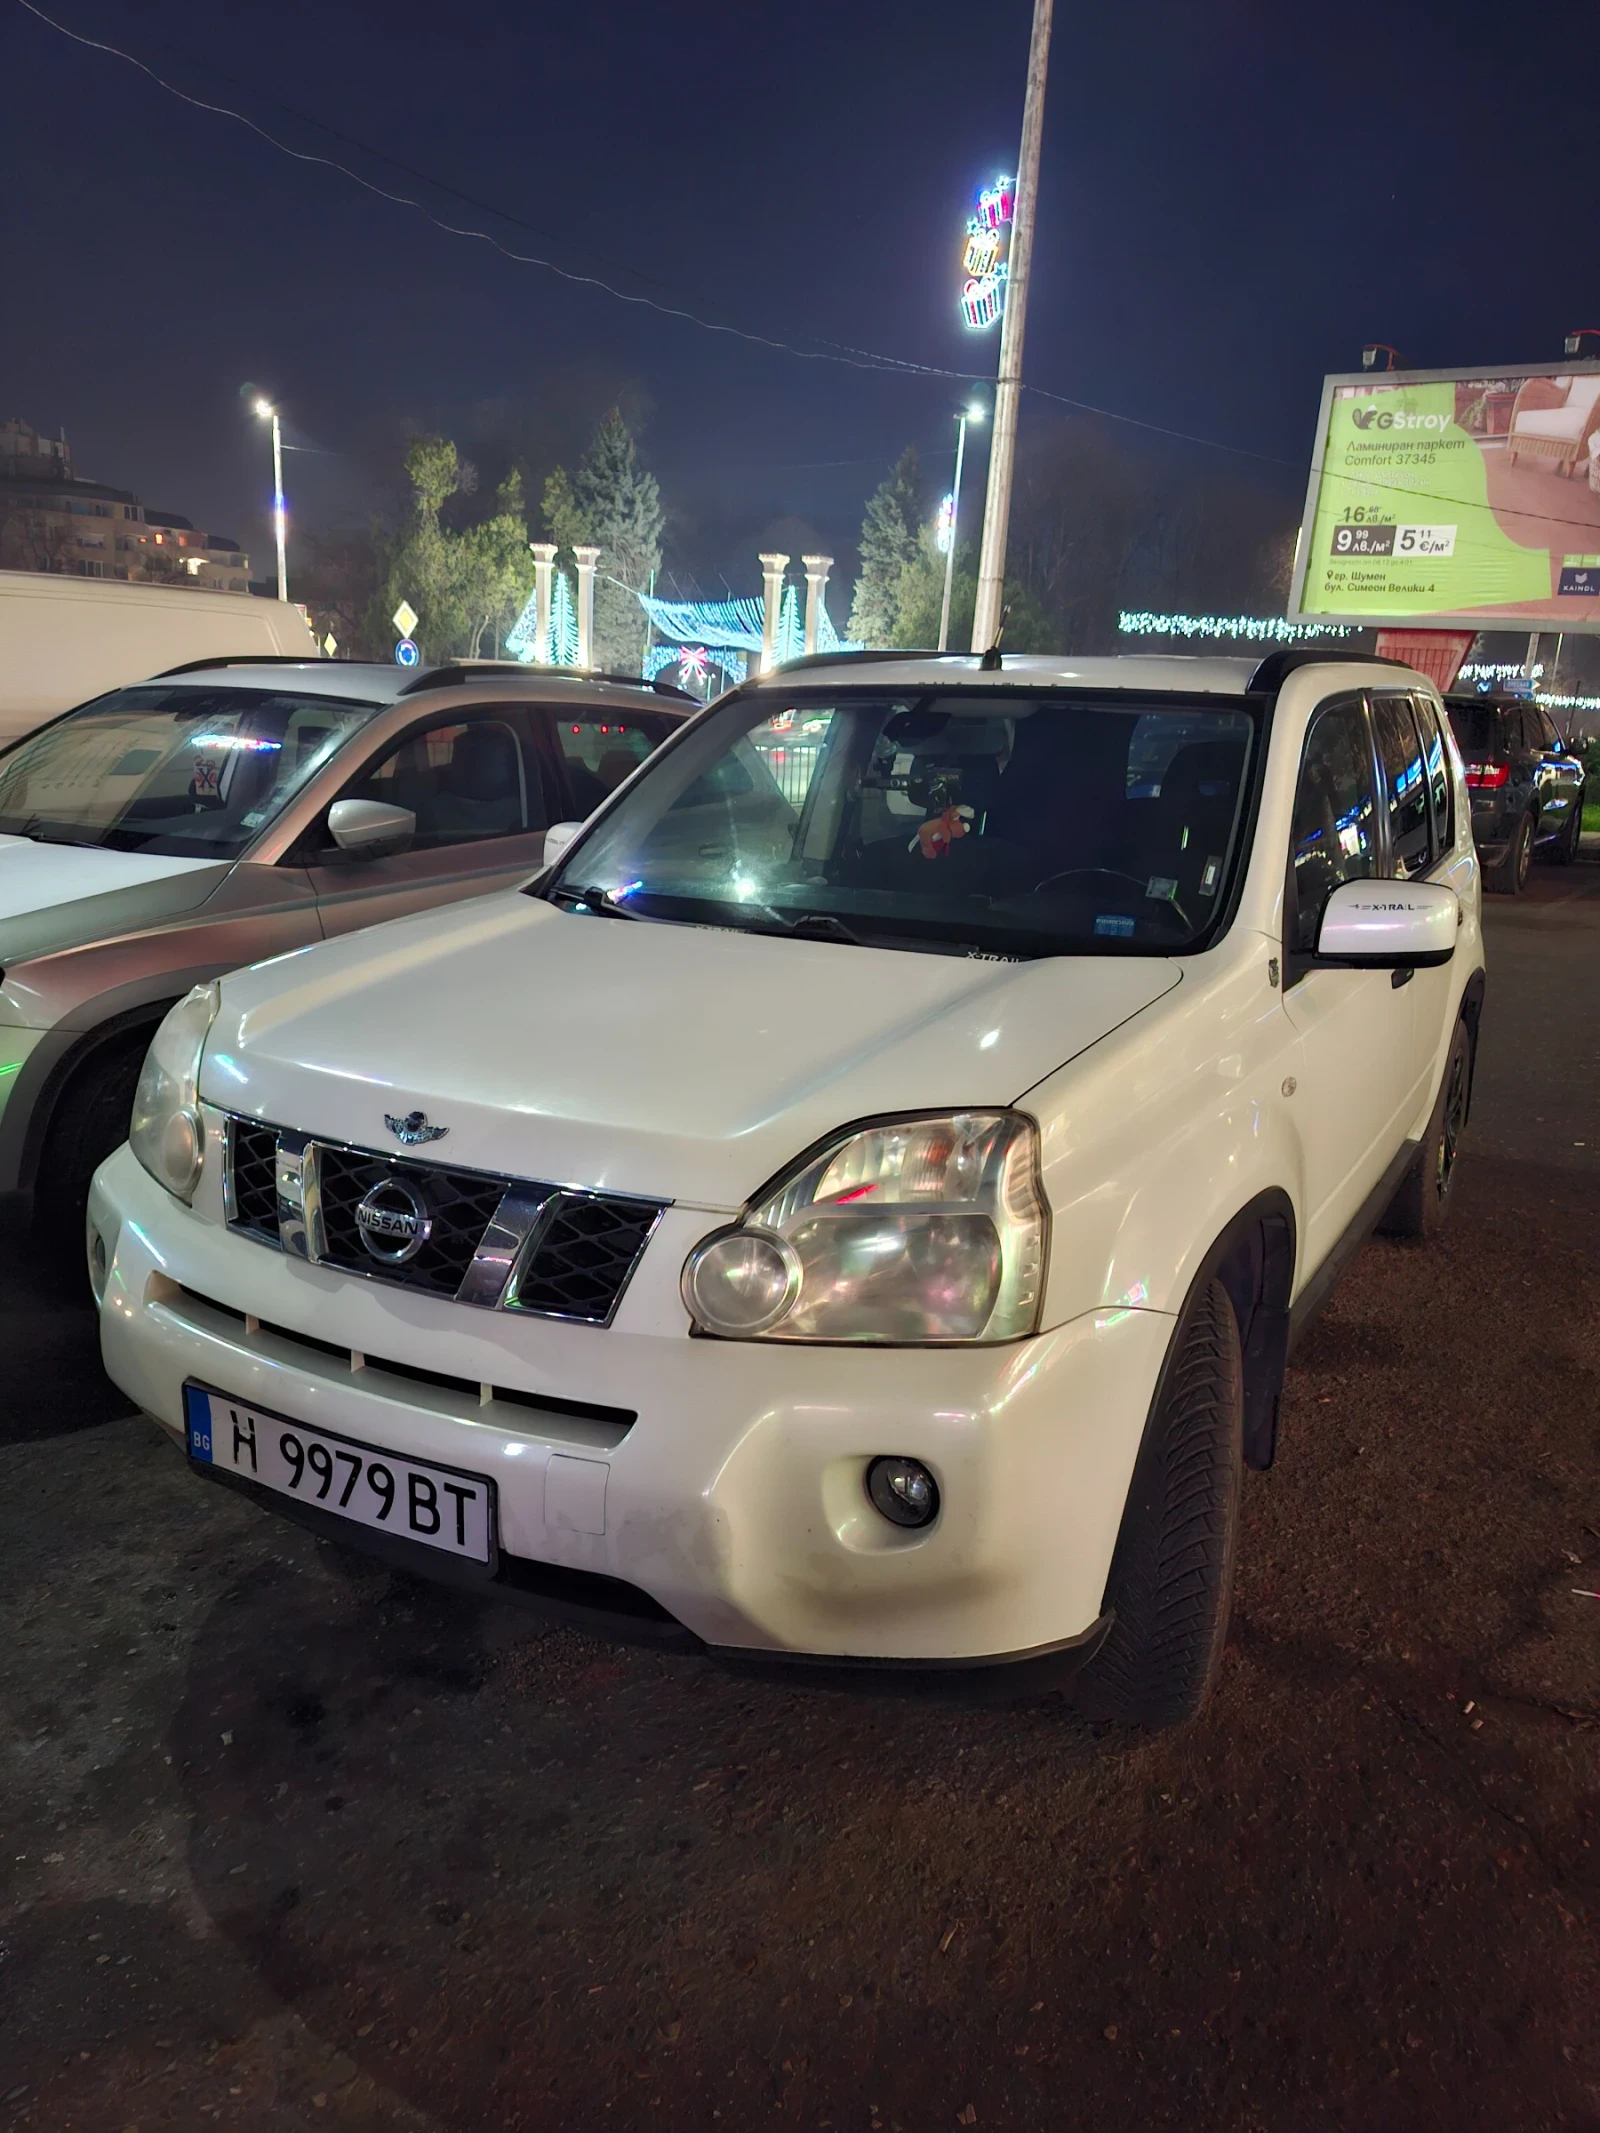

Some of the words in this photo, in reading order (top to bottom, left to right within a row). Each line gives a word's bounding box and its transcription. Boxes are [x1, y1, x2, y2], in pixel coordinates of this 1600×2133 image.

[1346, 440, 1414, 453] Ламиниран
[1416, 438, 1465, 452] паркет
[1344, 454, 1392, 466] Comfort
[1395, 452, 1436, 465] 37345
[1343, 506, 1366, 523] 16
[1336, 529, 1353, 552] 9
[1355, 529, 1369, 540] 99
[1400, 529, 1416, 551] 5
[1420, 529, 1431, 539] 11
[1351, 571, 1386, 583] Шумен
[1347, 582, 1386, 592] Симеон
[1388, 583, 1425, 593] Велики
[1427, 583, 1435, 593] 4
[357, 1209, 419, 1236] NISSAN
[193, 1430, 211, 1451] BG
